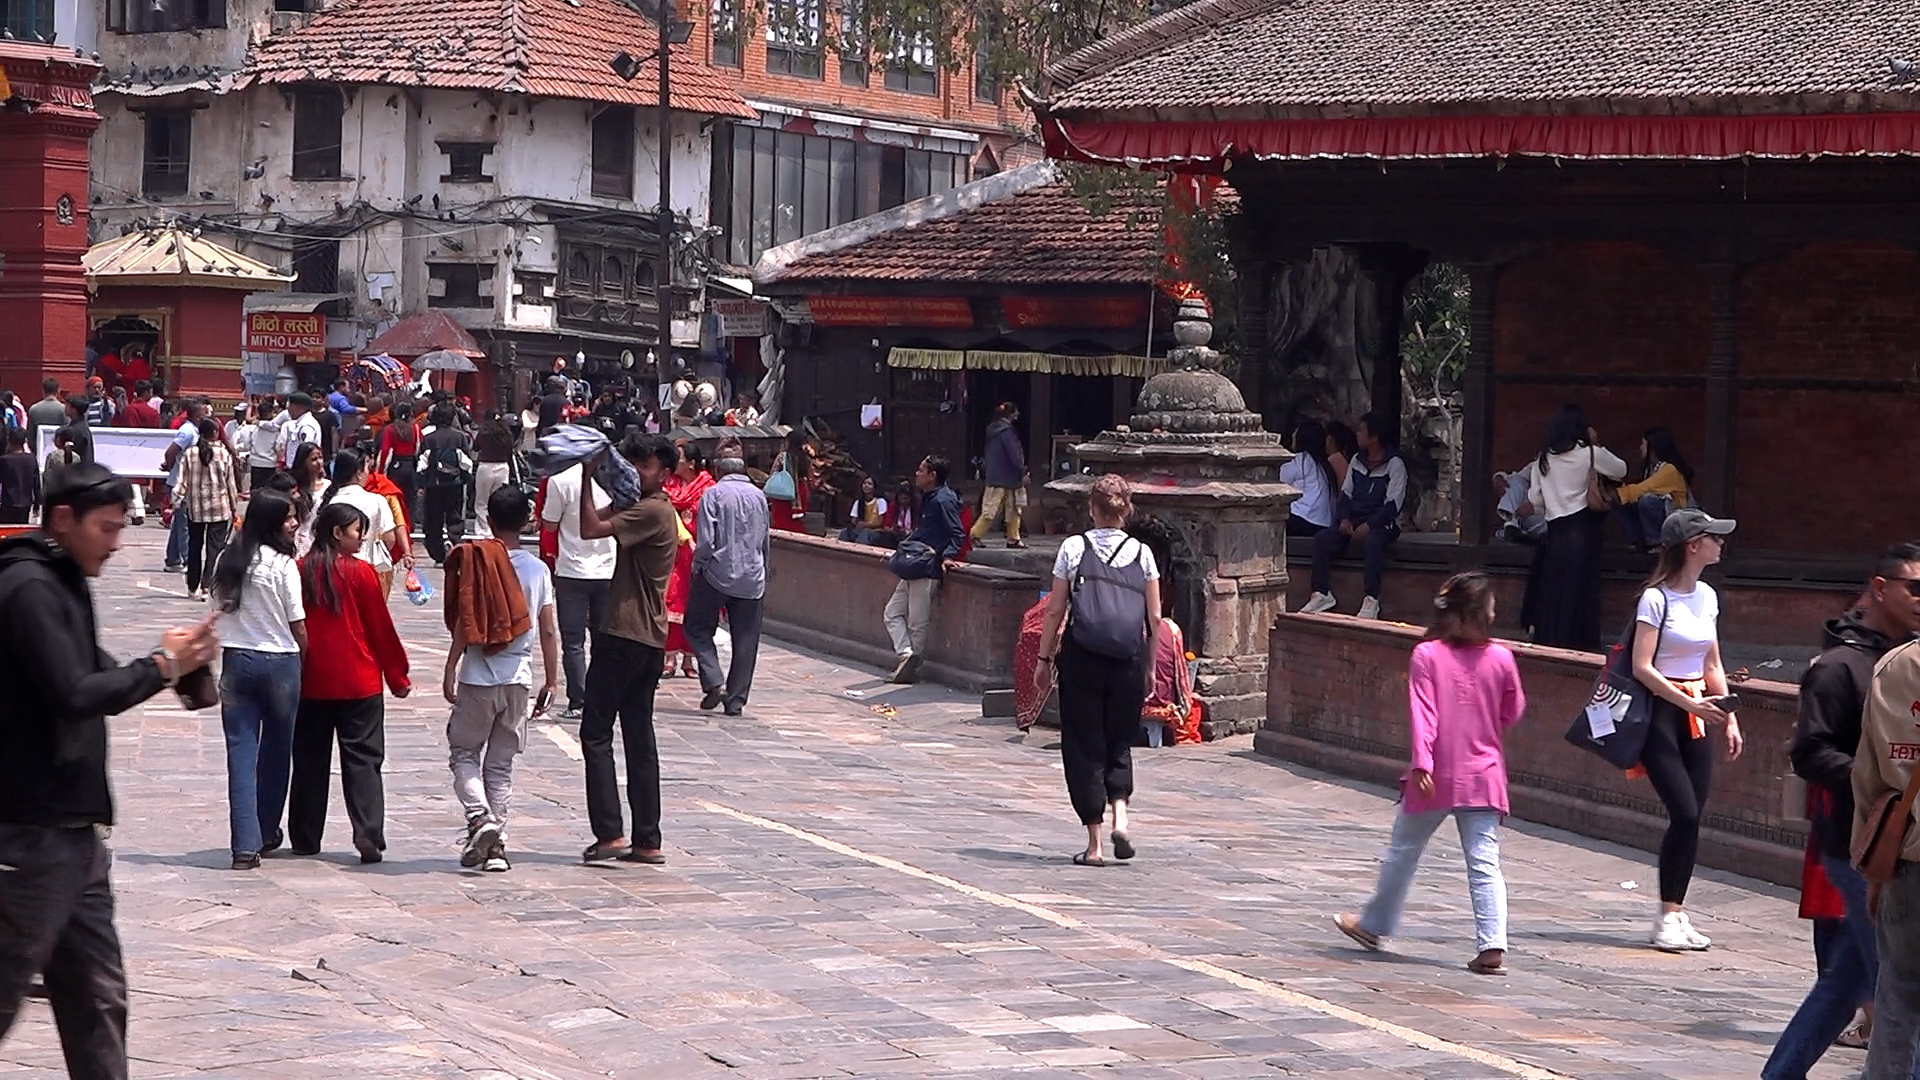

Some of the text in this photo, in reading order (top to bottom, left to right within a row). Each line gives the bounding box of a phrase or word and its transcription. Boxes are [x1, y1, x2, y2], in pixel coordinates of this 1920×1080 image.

[252, 314, 318, 334] मिठो लस्सी
[250, 335, 322, 348] MITHO LASSI
